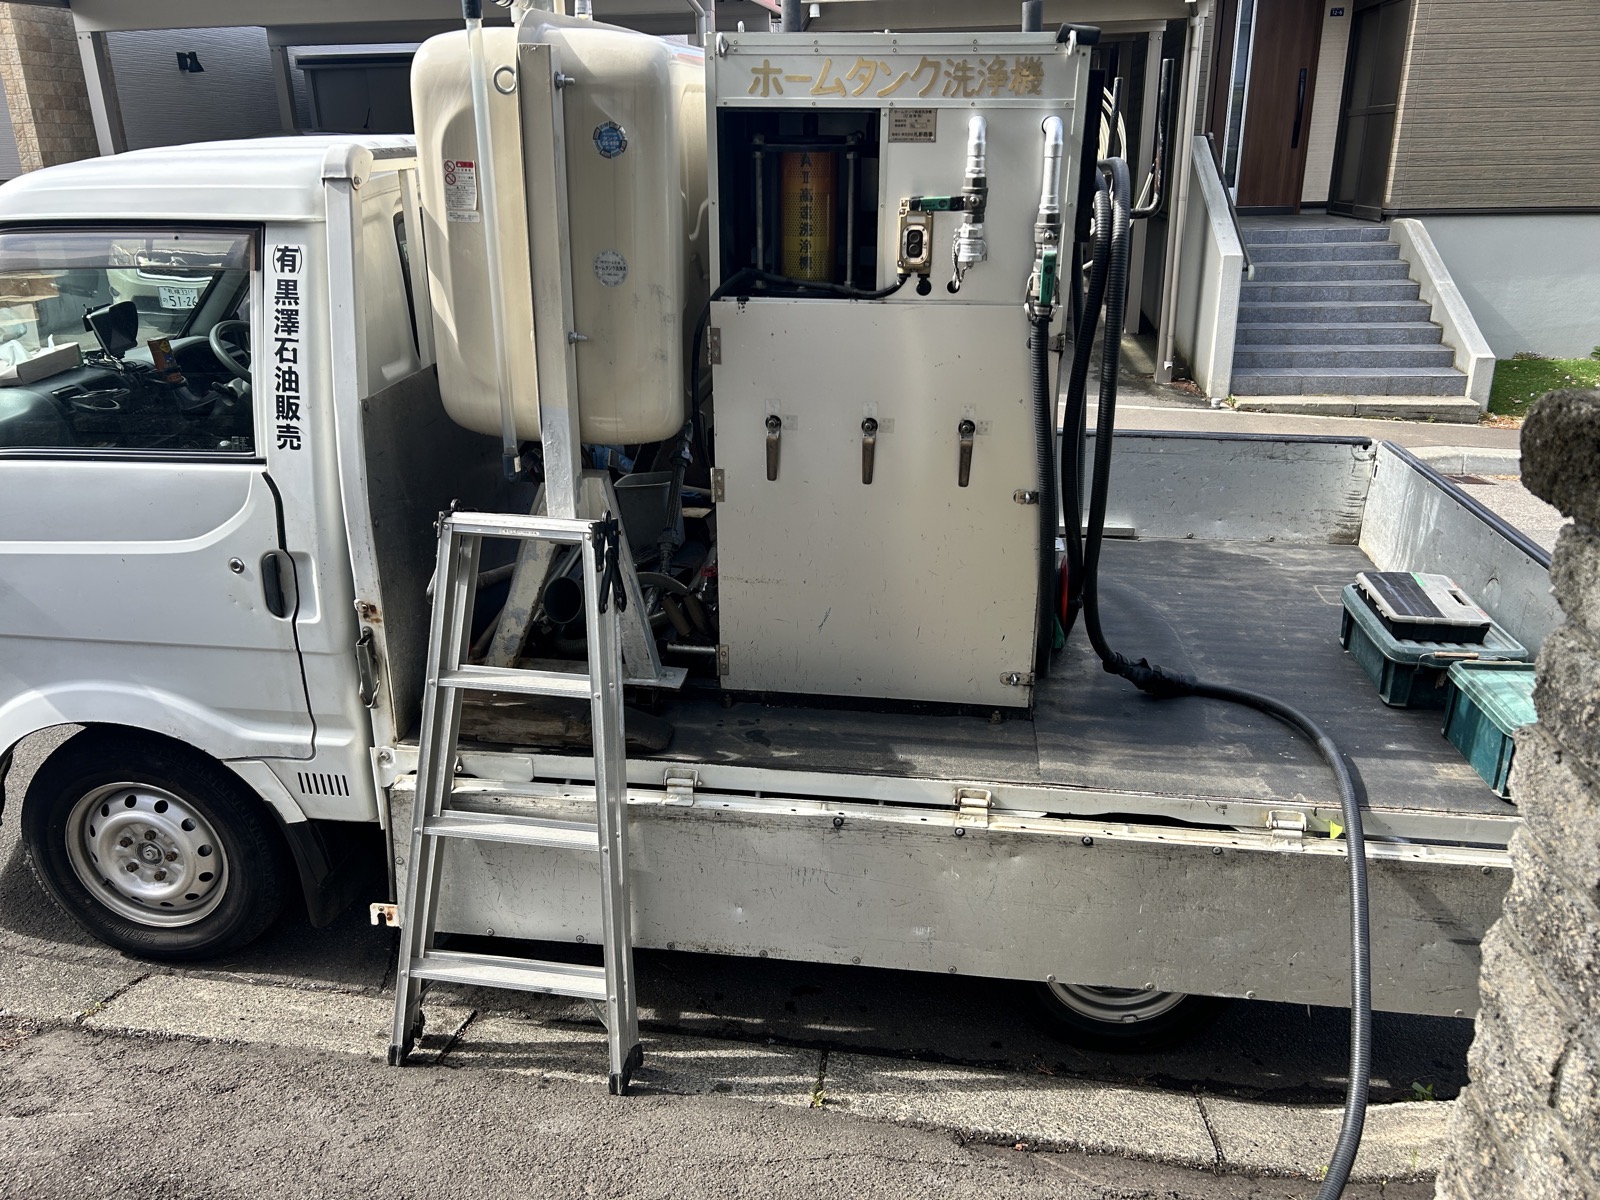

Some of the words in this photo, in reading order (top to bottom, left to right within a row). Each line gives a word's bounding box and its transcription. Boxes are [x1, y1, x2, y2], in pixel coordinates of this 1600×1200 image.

[747, 56, 1045, 98] ホームタンク洗浄機
